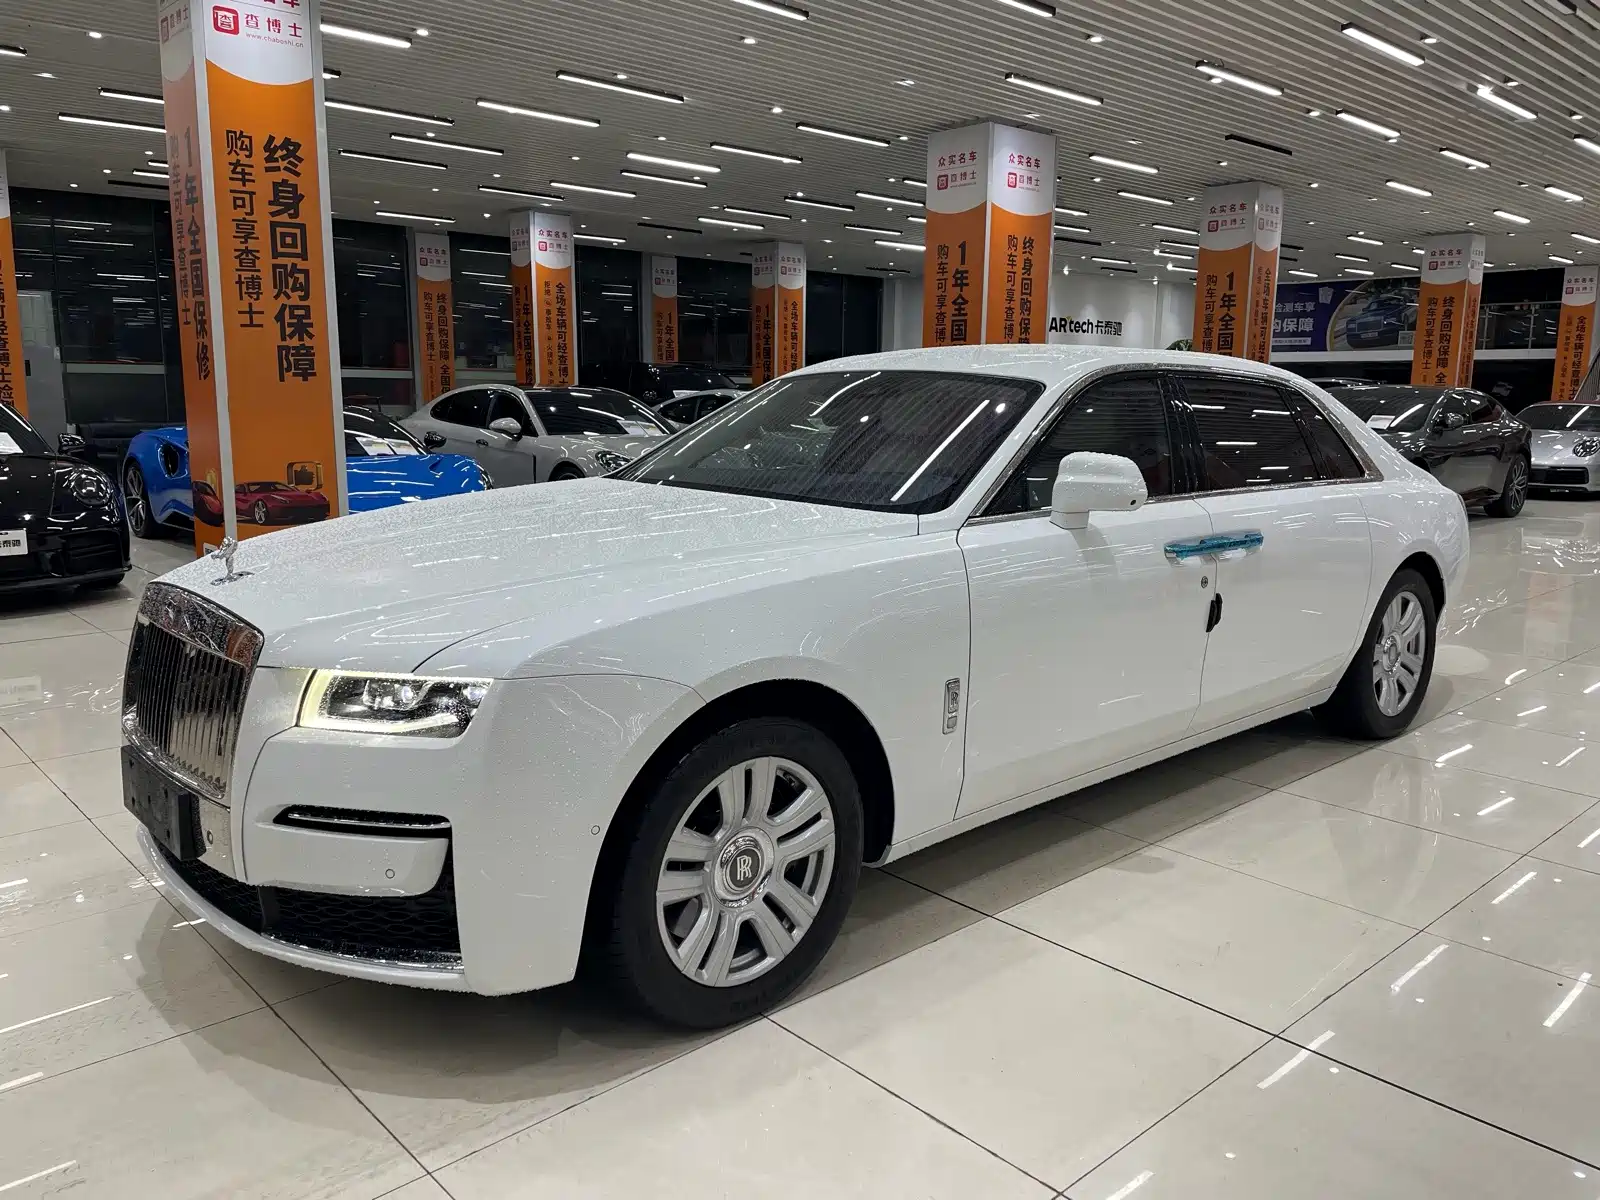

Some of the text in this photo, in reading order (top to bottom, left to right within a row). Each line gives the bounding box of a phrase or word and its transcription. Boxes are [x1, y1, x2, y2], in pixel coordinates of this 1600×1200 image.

[244, 13, 302, 38] 查博士
[246, 32, 303, 48] www.chaboshi.cn
[938, 150, 977, 167] 众实名车
[1008, 152, 1040, 169] 众实名车
[226, 130, 264, 328] 购车可享查博士
[1209, 202, 1247, 214] 众实名车
[263, 134, 317, 382] 终身回购保障
[935, 244, 949, 346] 购车可享查博
[951, 240, 969, 345] 1年全国
[1004, 235, 1018, 343] 购车可享查博
[1217, 272, 1236, 356] 1年全国
